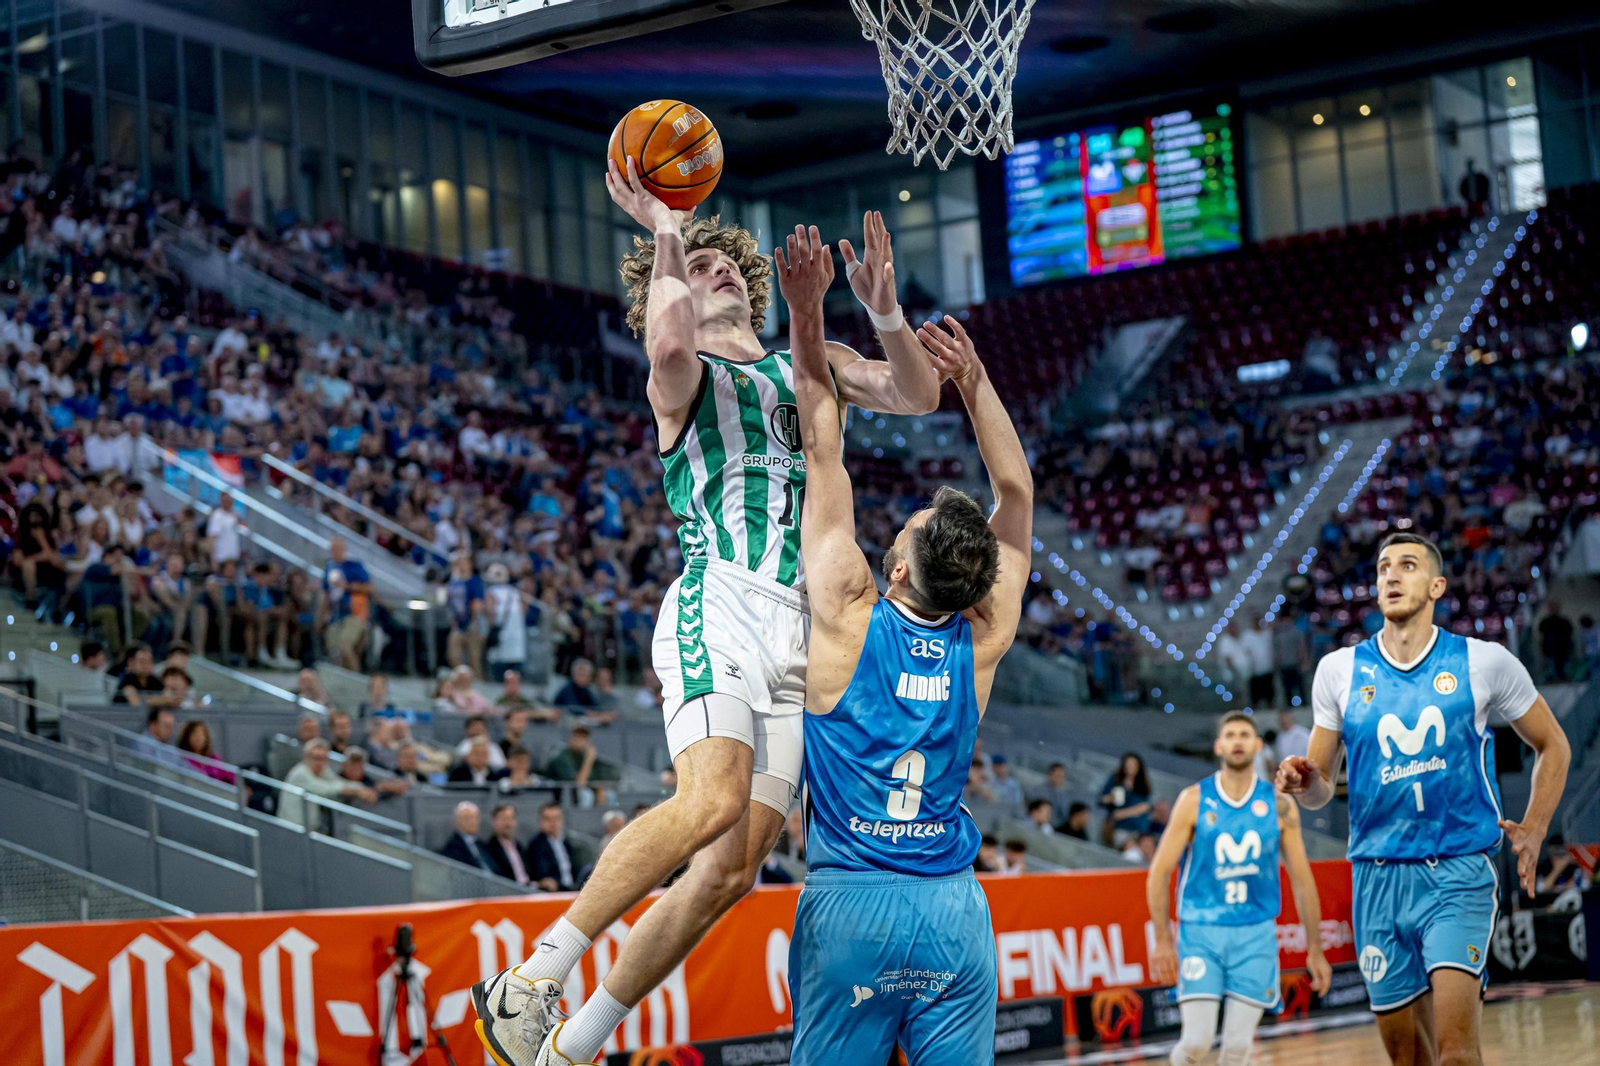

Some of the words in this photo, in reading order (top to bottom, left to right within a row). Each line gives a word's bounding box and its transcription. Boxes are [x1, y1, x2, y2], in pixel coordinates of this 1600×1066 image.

[741, 454, 793, 469] GRUPO
[909, 637, 946, 660] as
[895, 669, 951, 702] ANDRIĆ
[885, 749, 927, 821] 3
[1380, 754, 1447, 786] Estudiantes
[1412, 781, 1425, 813] 1
[903, 968, 958, 981] Fundación
[996, 922, 1144, 999] FINAL
[879, 978, 928, 995] Jiménez
[929, 979, 952, 994] Dí
